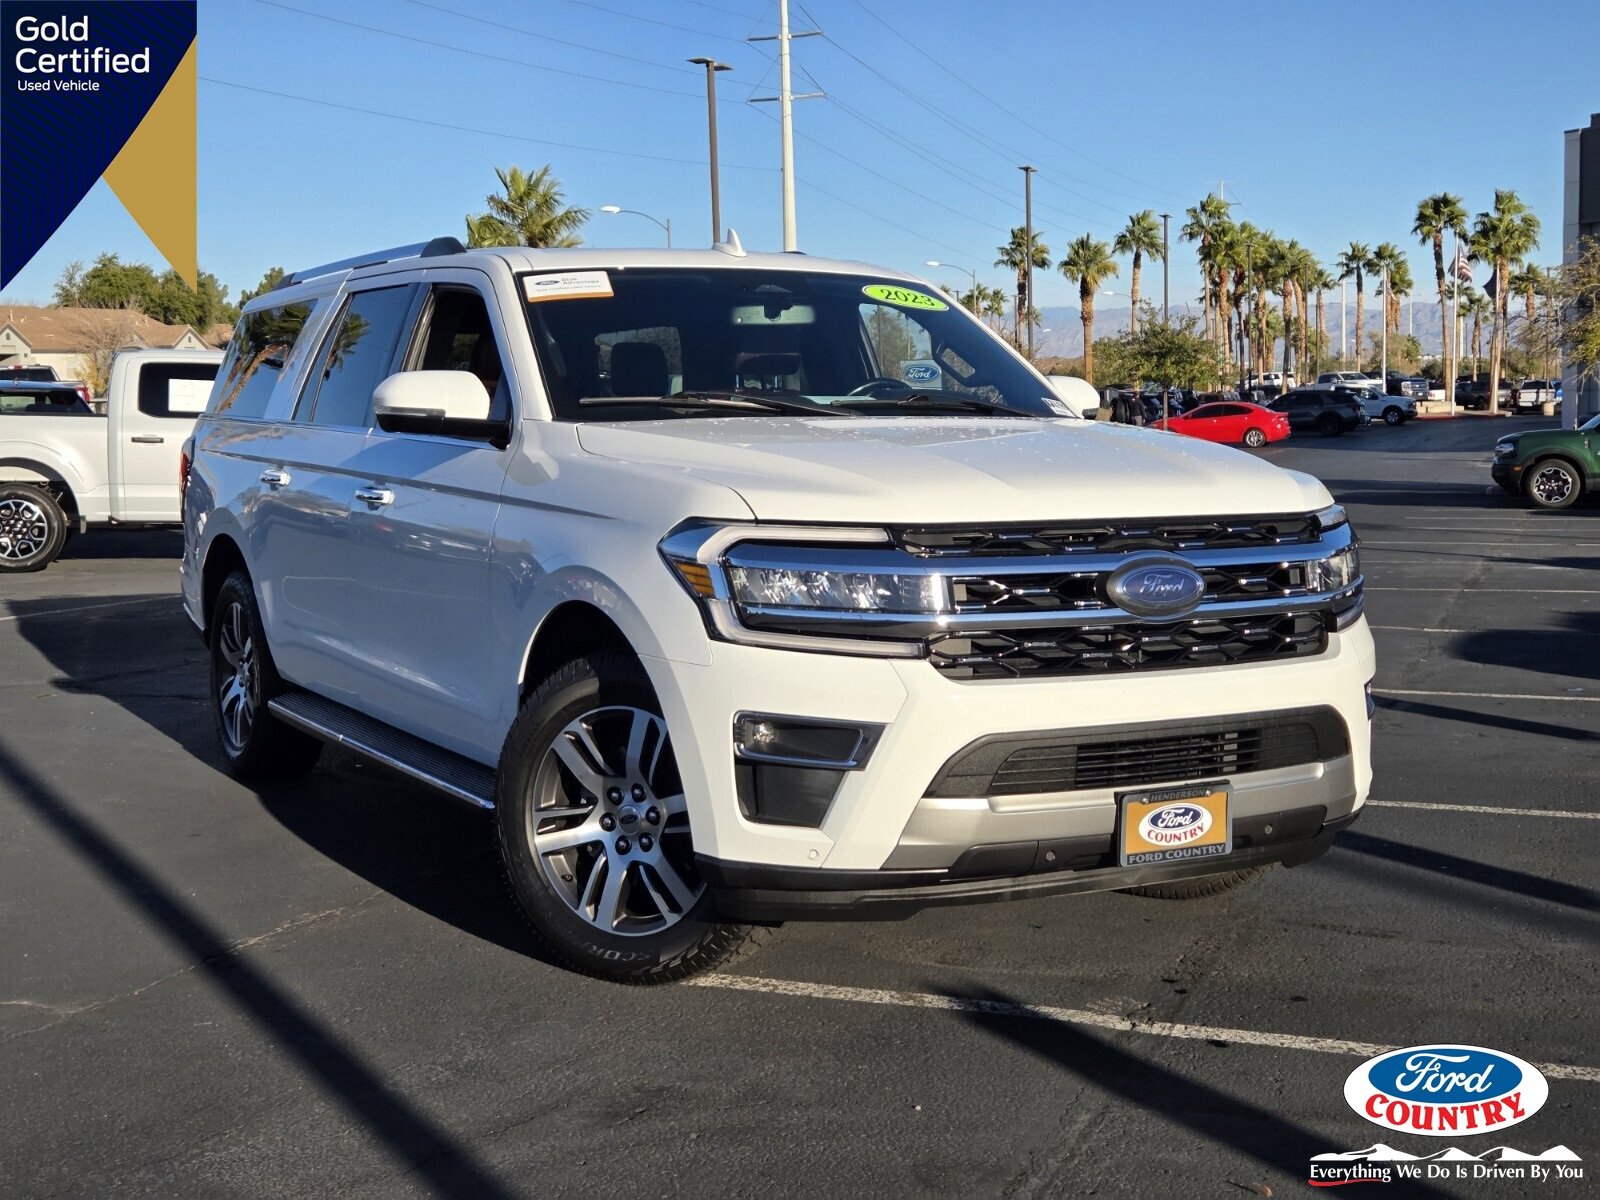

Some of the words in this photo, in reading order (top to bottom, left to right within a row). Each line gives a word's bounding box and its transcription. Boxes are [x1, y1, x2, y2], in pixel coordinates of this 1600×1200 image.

[880, 288, 935, 307] 2023
[908, 367, 931, 378] Ford
[1139, 573, 1185, 597] Ford
[1150, 789, 1206, 801] HENDERSON
[1157, 808, 1194, 828] Ford
[1147, 822, 1205, 843] COUNTRY
[1128, 852, 1163, 864] FORD
[1165, 844, 1224, 859] COUNTRY
